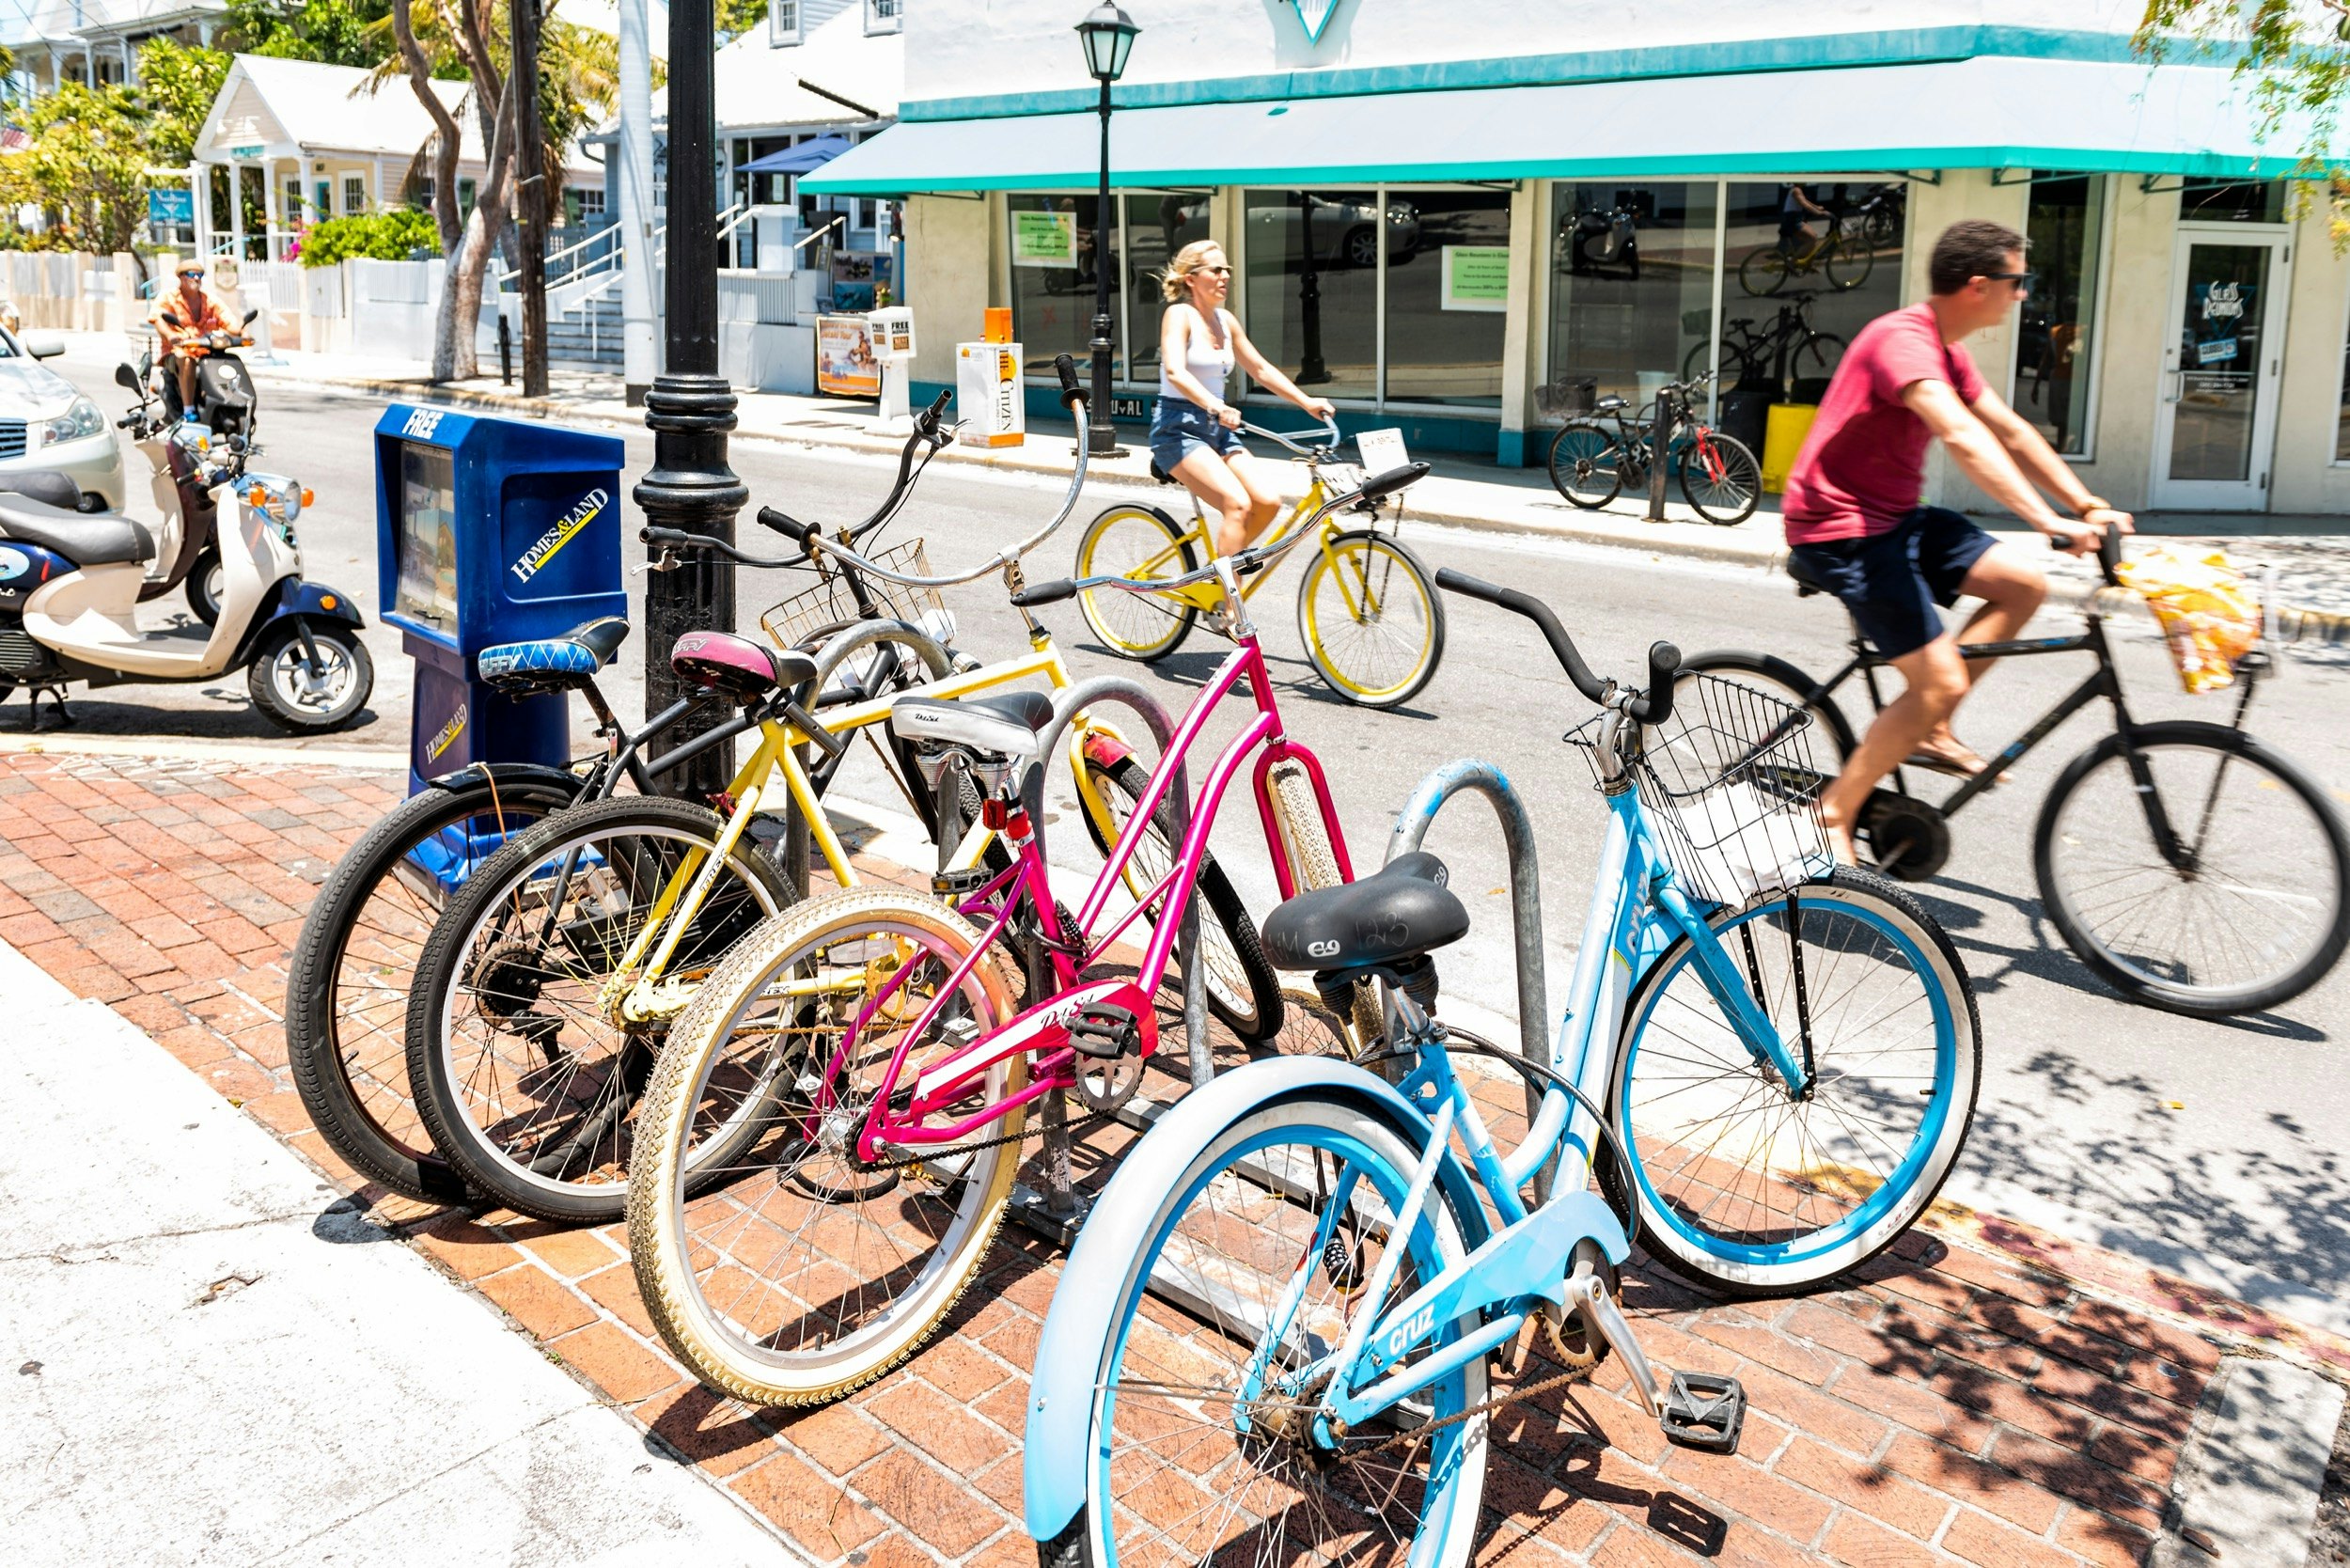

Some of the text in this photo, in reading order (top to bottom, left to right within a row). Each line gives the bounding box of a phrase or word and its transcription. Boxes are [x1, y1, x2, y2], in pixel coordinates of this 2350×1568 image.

[891, 321, 909, 329] FREE
[401, 409, 444, 439] FREE
[1000, 378, 1014, 431] CITIZEN
[510, 488, 609, 584] HOMES&LAND
[1355, 912, 1409, 949] 123
[1388, 1302, 1434, 1356] cruz
